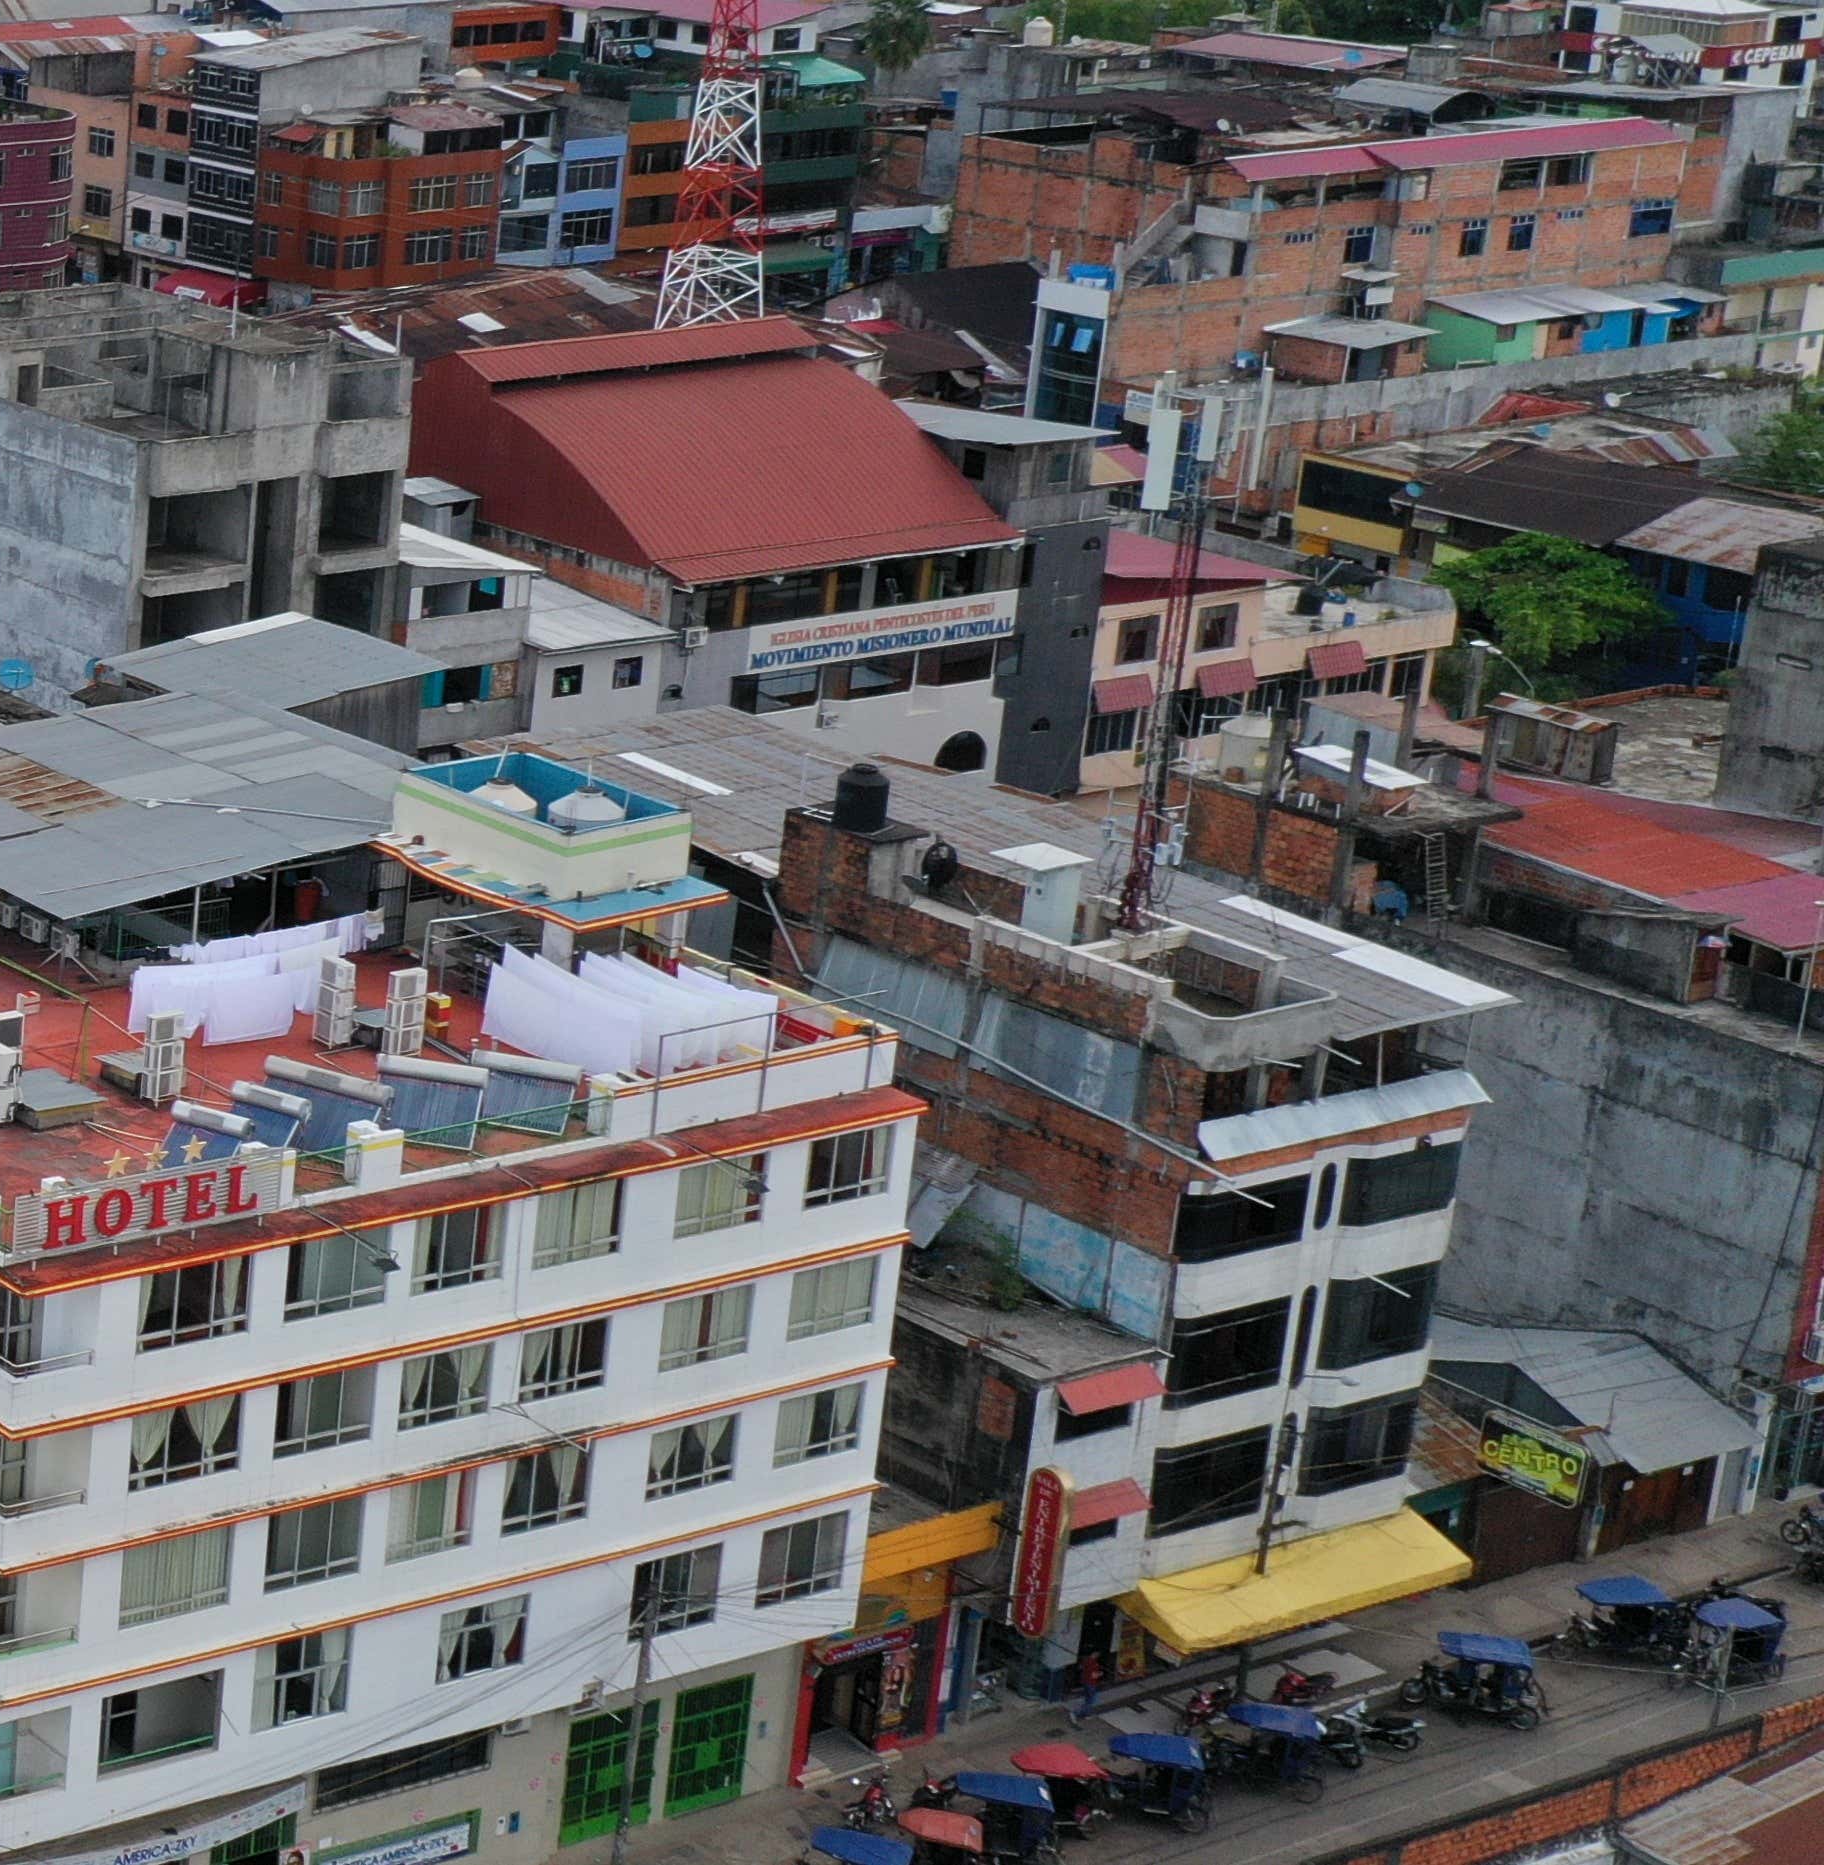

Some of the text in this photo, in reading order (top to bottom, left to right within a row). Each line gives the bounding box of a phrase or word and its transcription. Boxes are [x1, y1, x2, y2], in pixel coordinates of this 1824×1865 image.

[750, 616, 1015, 671] MOVIMIENTO MISIONERO MUNDIAL
[42, 1165, 257, 1251] HOTEL
[1483, 1440, 1578, 1476] CENTRO
